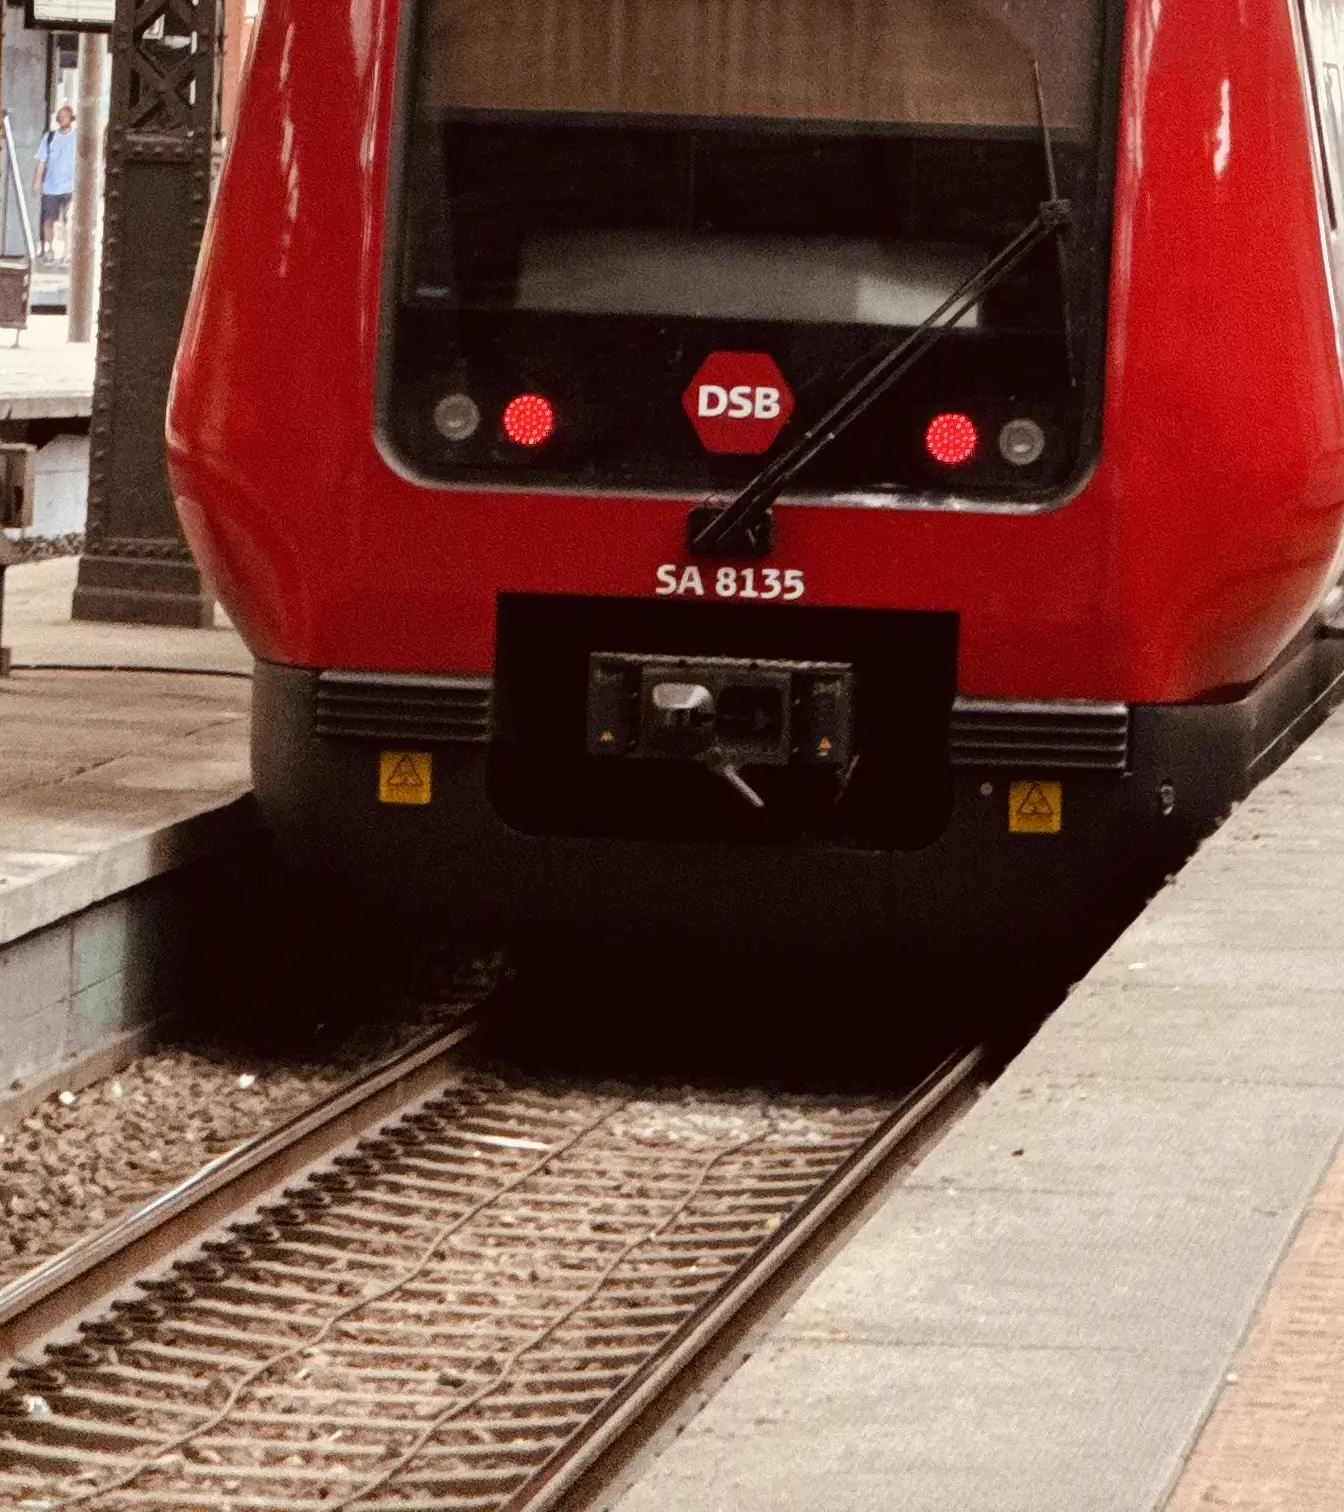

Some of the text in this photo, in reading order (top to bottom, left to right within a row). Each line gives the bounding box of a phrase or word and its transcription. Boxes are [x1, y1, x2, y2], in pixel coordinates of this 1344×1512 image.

[697, 384, 782, 420] DSB
[655, 563, 806, 601] SA 8135
